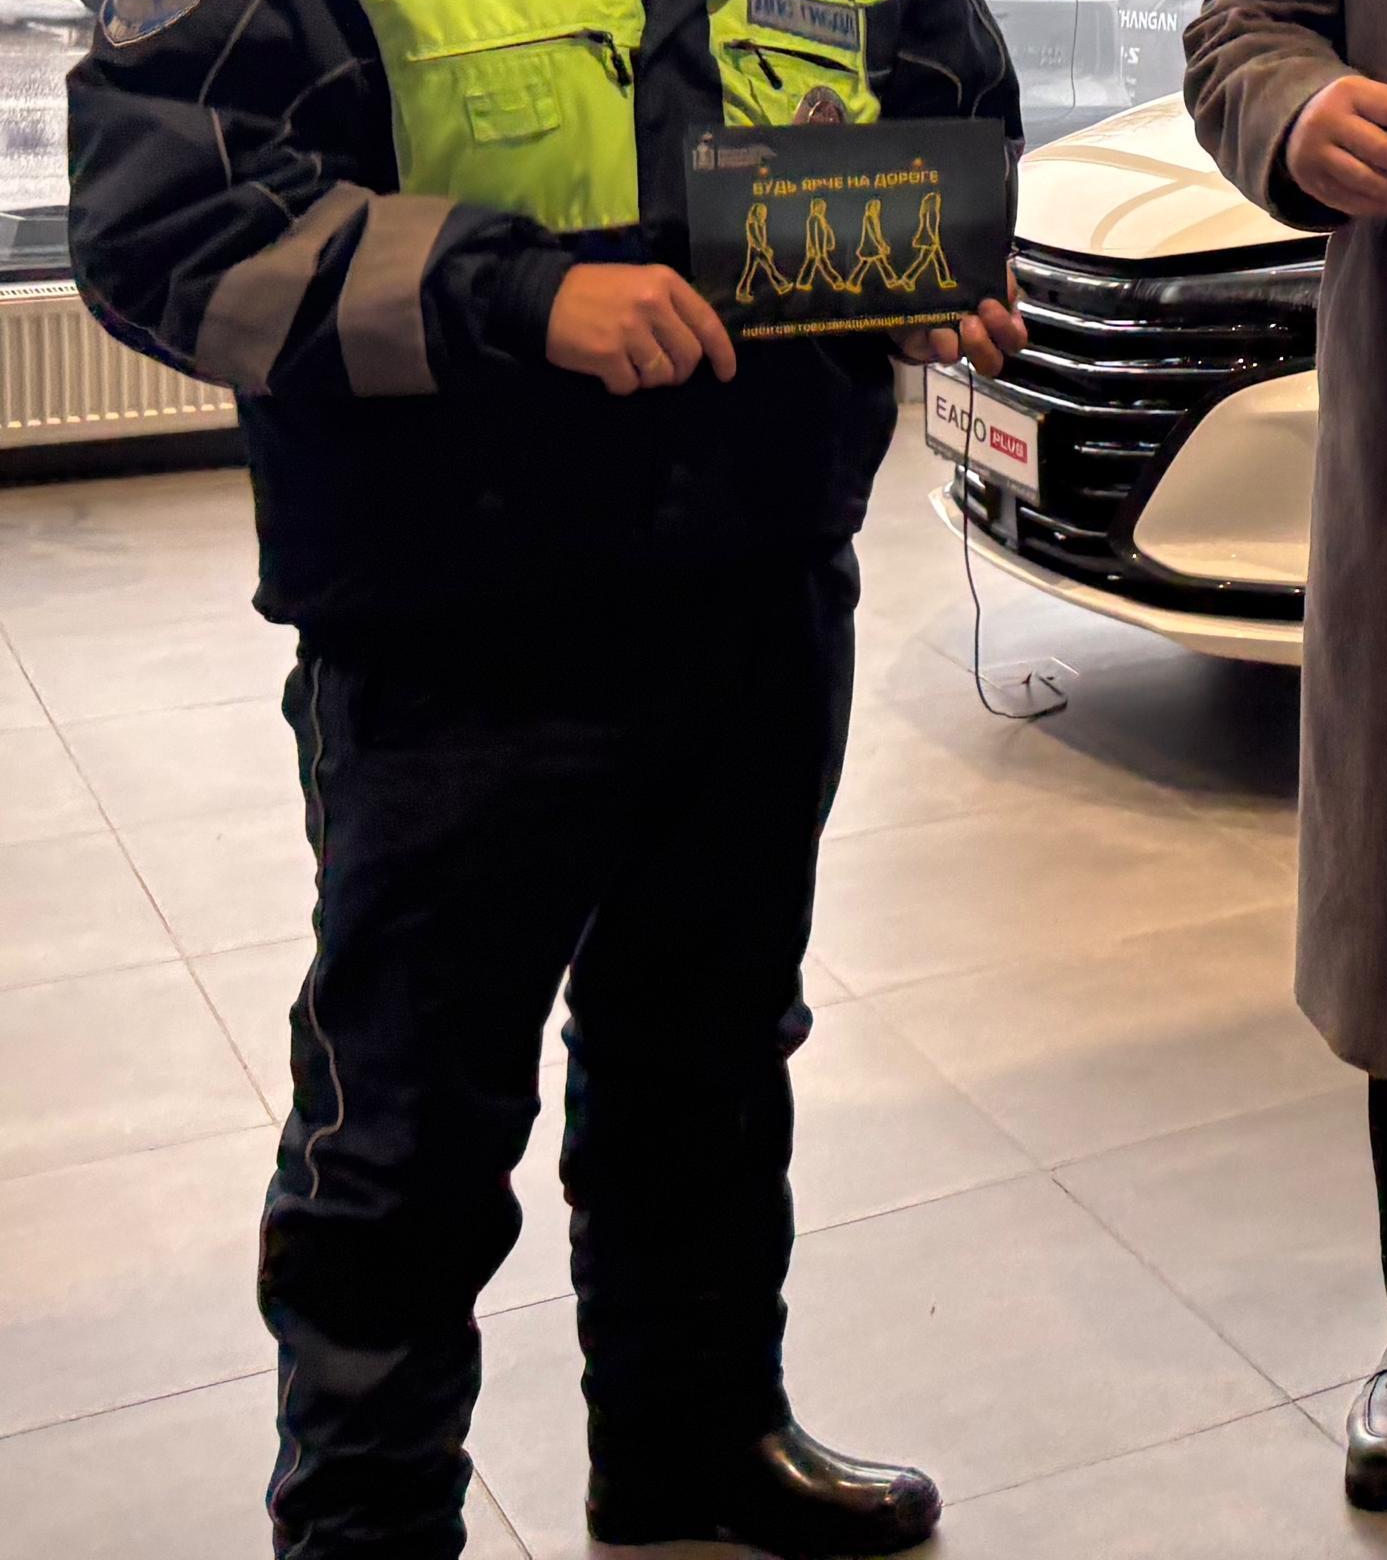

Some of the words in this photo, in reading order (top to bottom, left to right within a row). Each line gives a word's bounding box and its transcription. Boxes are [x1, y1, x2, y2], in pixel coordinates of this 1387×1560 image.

[1118, 9, 1178, 32] HANGAN
[847, 175, 871, 189] НА
[874, 169, 940, 189] ДОРОГЕ
[936, 395, 987, 442] EADO
[991, 429, 1025, 456] PLUS
